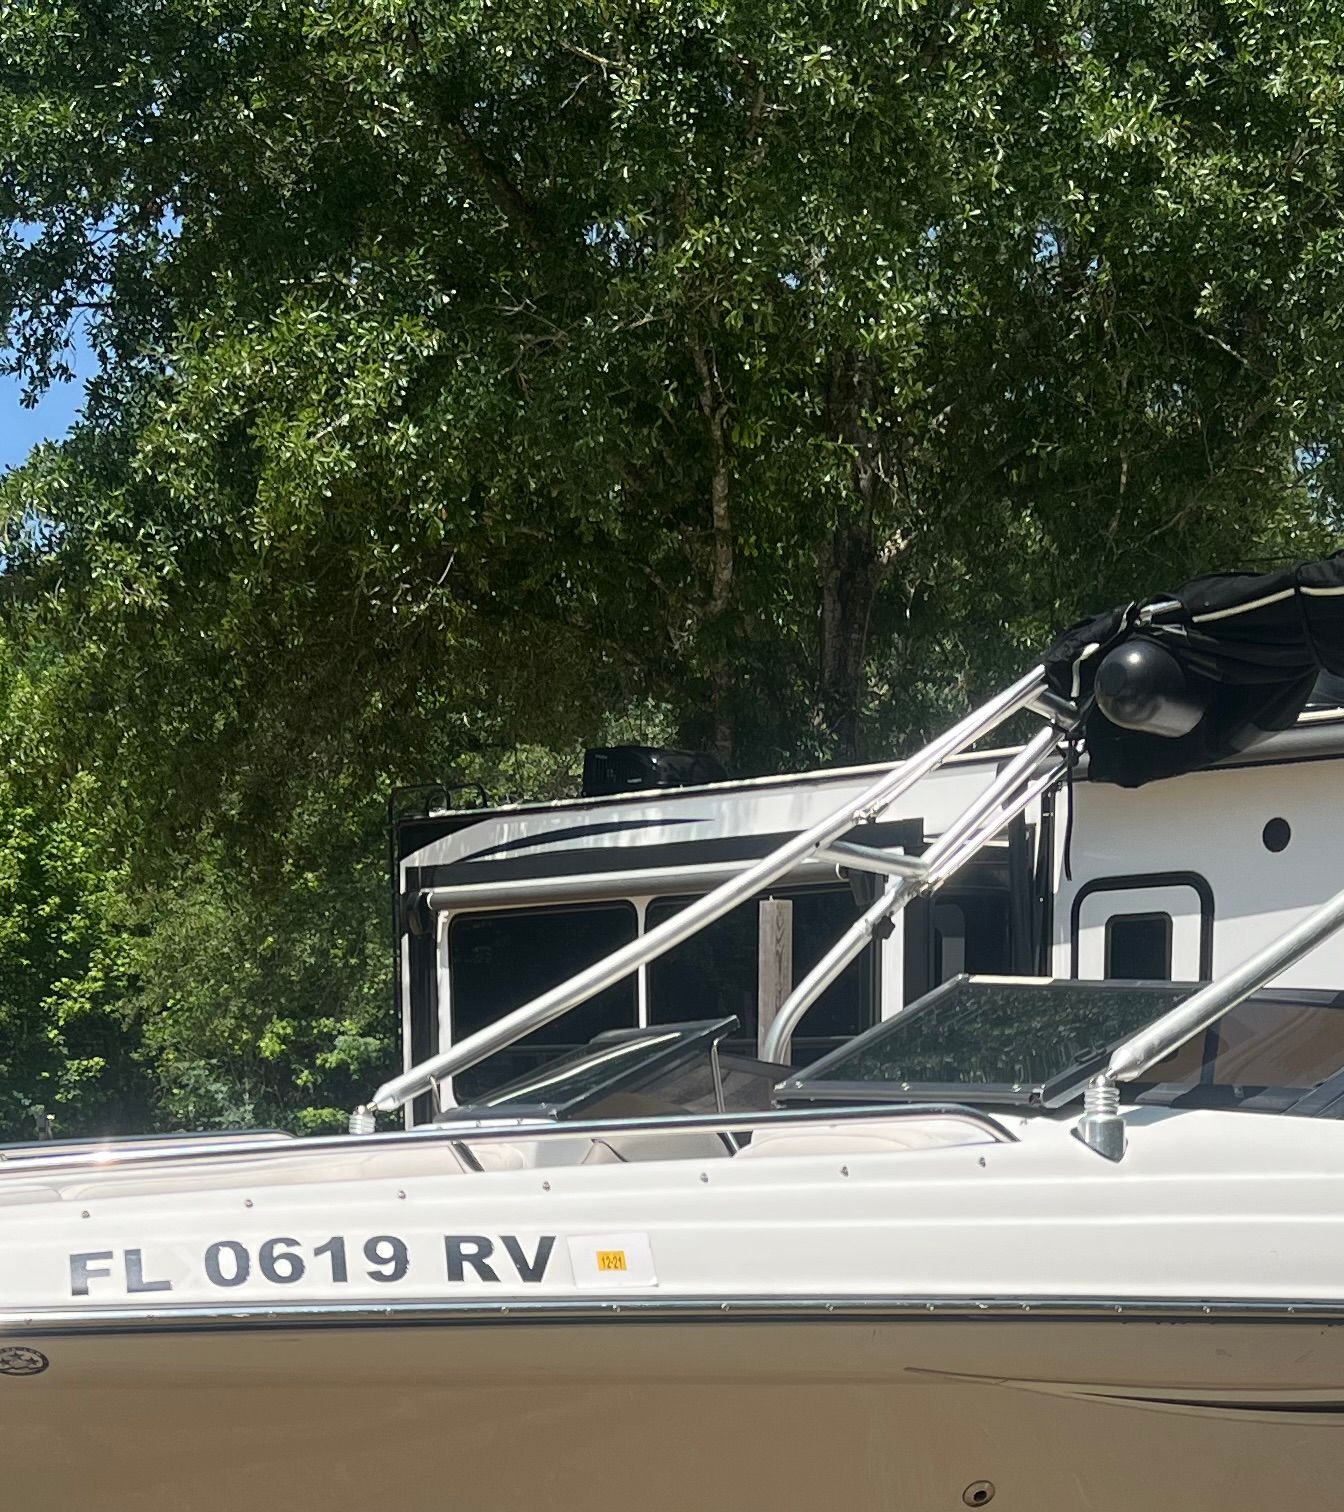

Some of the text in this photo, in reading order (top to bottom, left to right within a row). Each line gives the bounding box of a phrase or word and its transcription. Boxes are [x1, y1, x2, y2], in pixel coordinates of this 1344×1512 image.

[69, 1234, 557, 1297] FL 0619 RV
